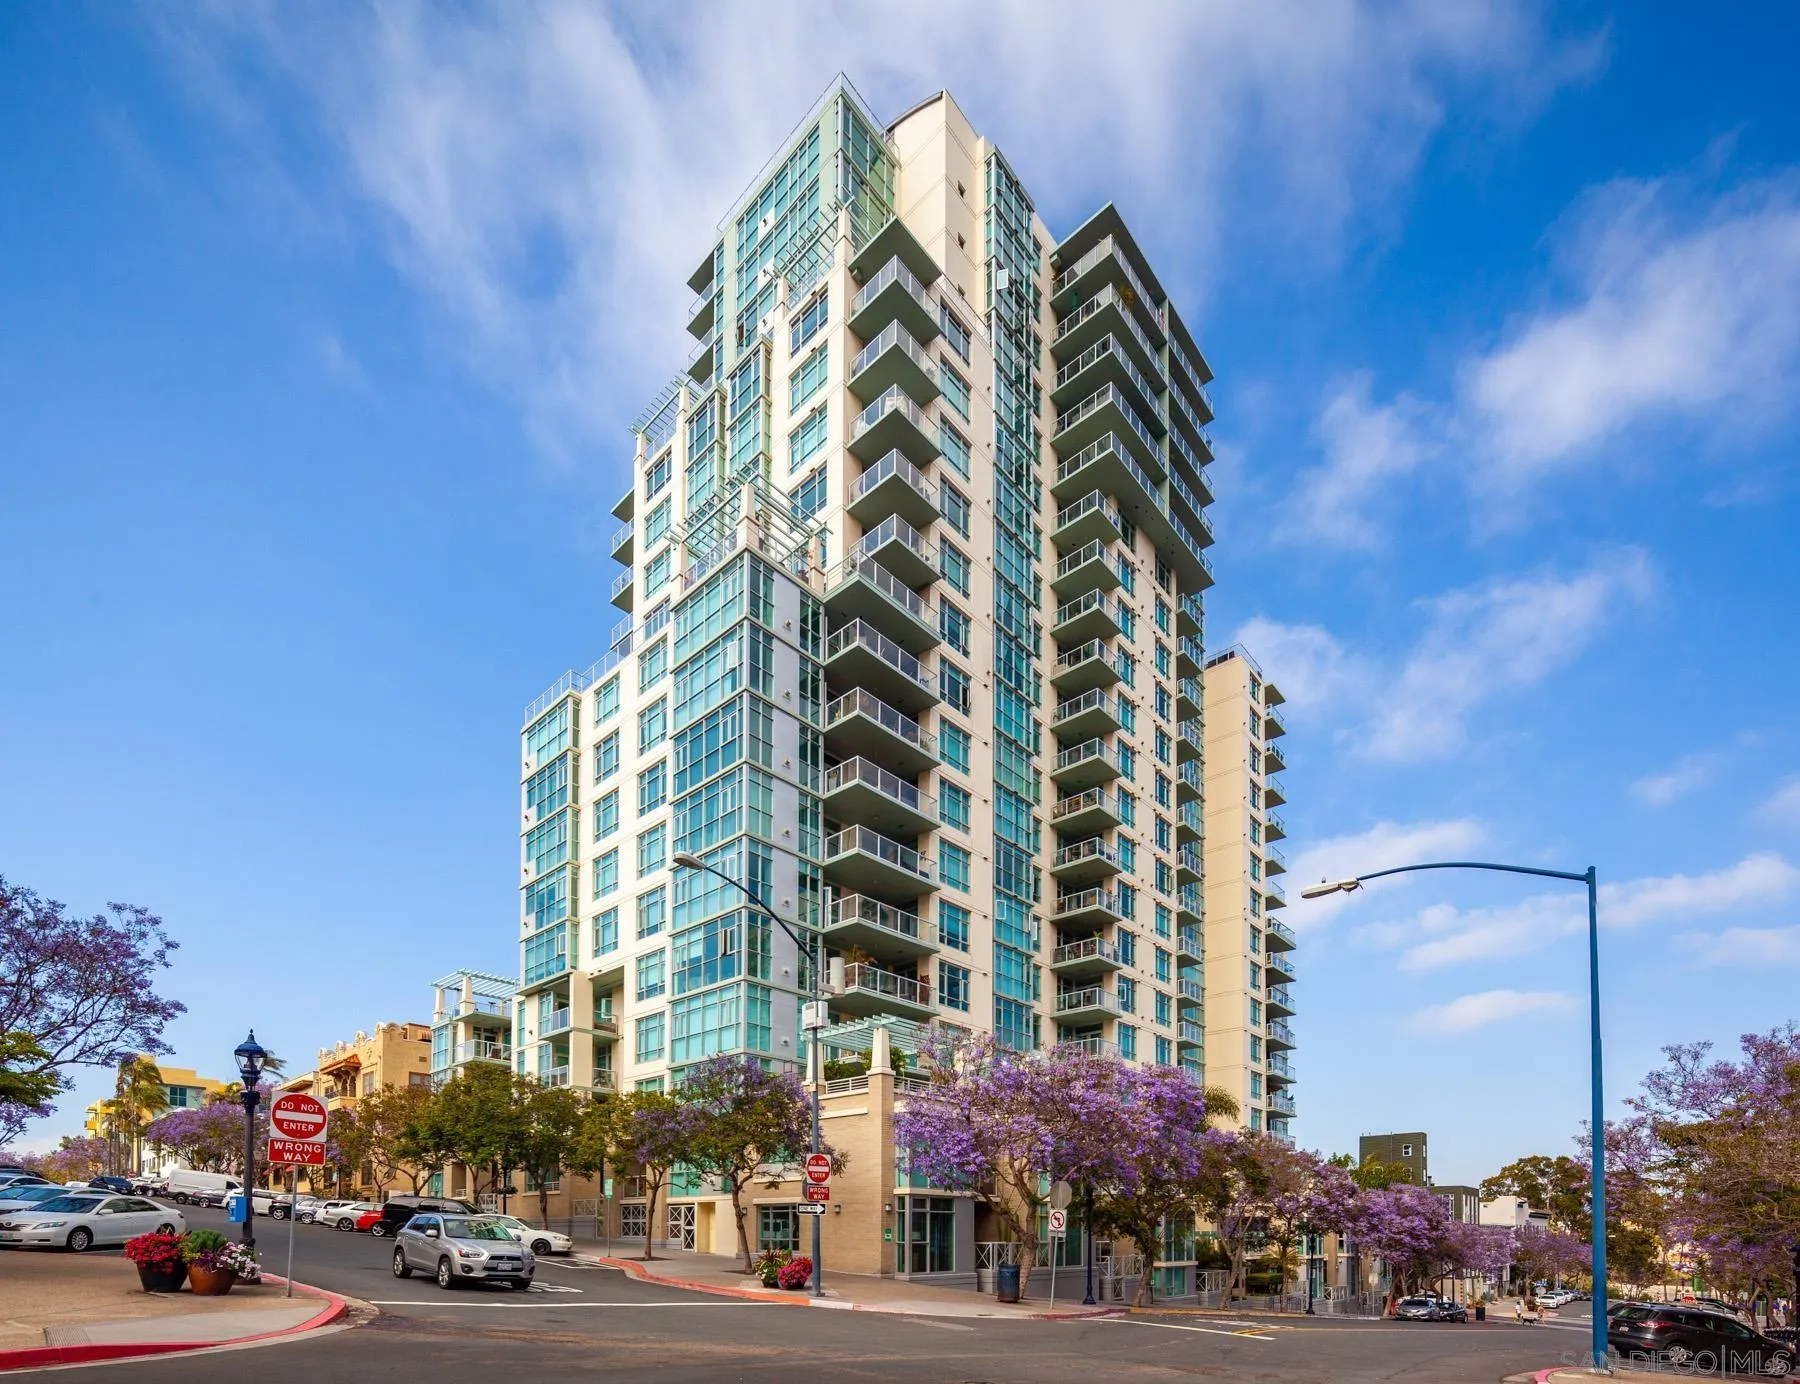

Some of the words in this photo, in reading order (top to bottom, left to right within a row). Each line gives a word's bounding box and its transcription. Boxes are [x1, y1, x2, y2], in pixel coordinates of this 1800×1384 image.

[281, 1101, 294, 1109] DO
[301, 1103, 319, 1112] NOT
[283, 1121, 314, 1131] ENTER
[273, 1141, 321, 1153] WRONG
[283, 1152, 311, 1162] WAY
